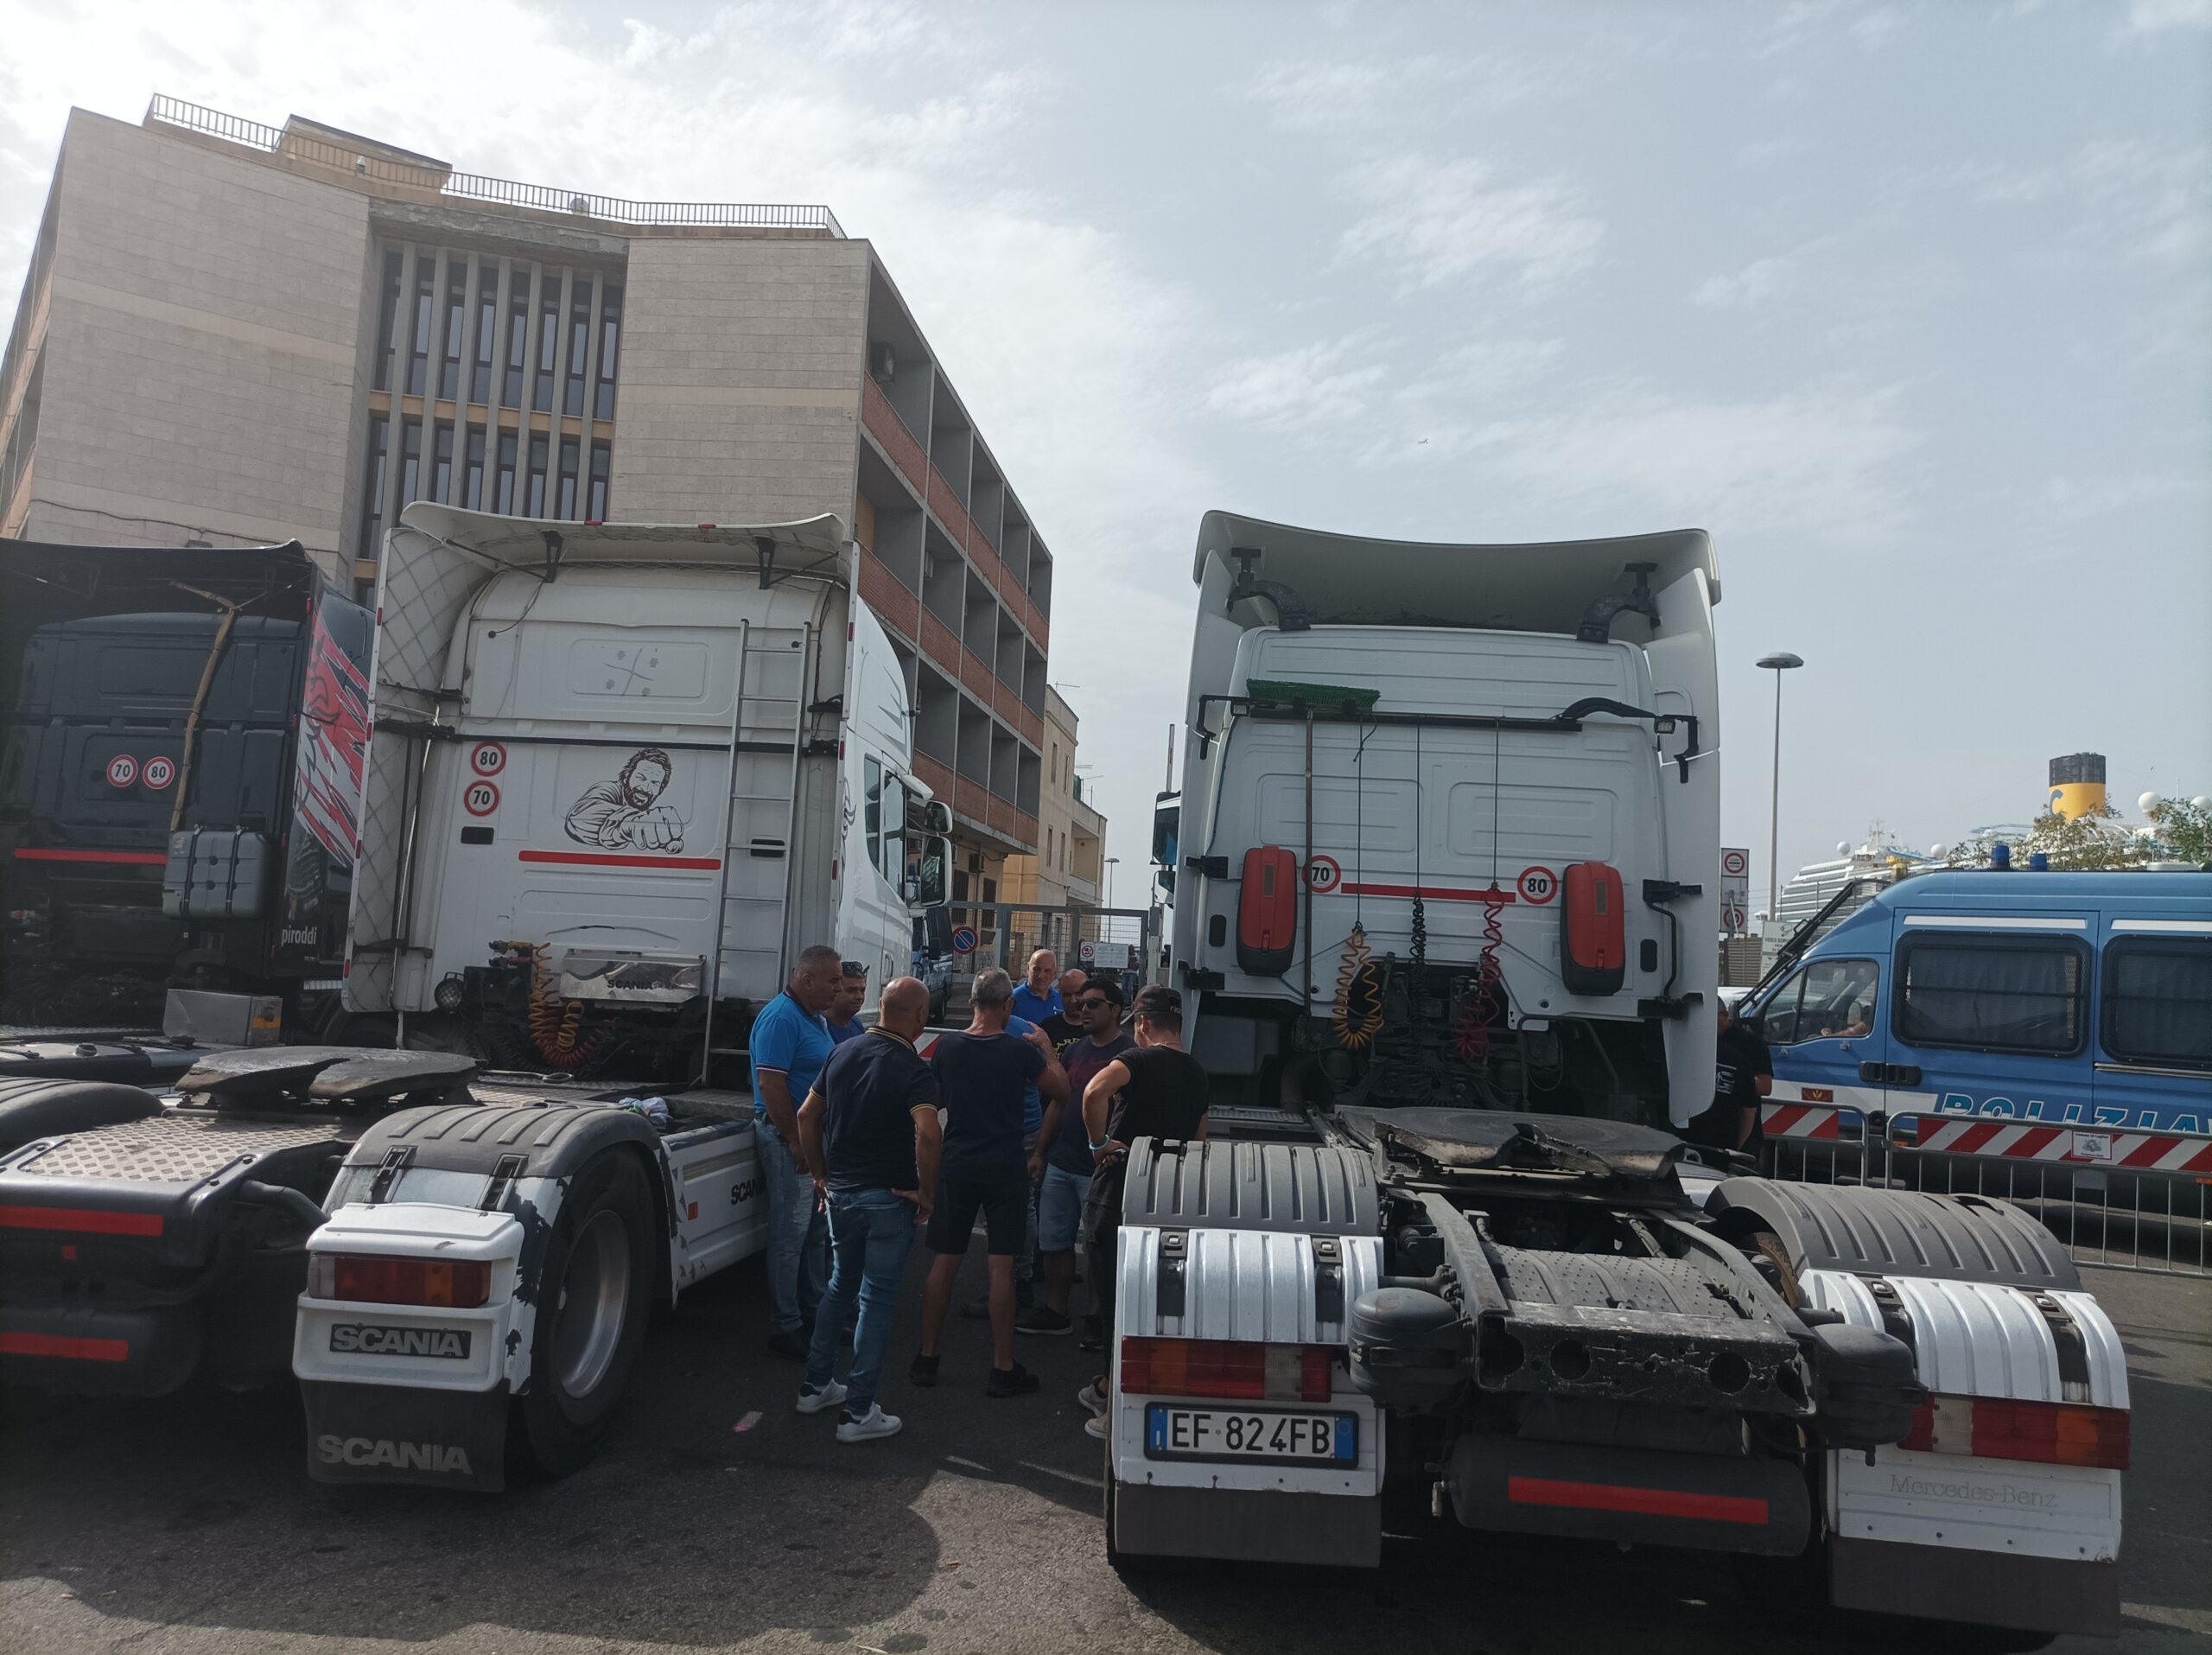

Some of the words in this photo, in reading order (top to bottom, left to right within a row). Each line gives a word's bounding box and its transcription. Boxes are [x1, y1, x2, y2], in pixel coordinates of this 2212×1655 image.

[480, 751, 498, 766] 80
[114, 764, 130, 778] 70
[150, 766, 167, 779] 80
[474, 790, 491, 805] 70
[1312, 867, 1330, 882] 70
[1528, 878, 1547, 893] 80
[281, 924, 318, 947] piroddi
[607, 979, 654, 990] SCANIA
[1942, 1092, 2200, 1135] POLIZIA
[332, 1327, 464, 1357] SCANIA
[1172, 1412, 1211, 1448] EF
[1225, 1416, 1331, 1454] 824FB
[317, 1434, 474, 1475] SCANIA
[1890, 1474, 2059, 1508] Mercedes-Benz
